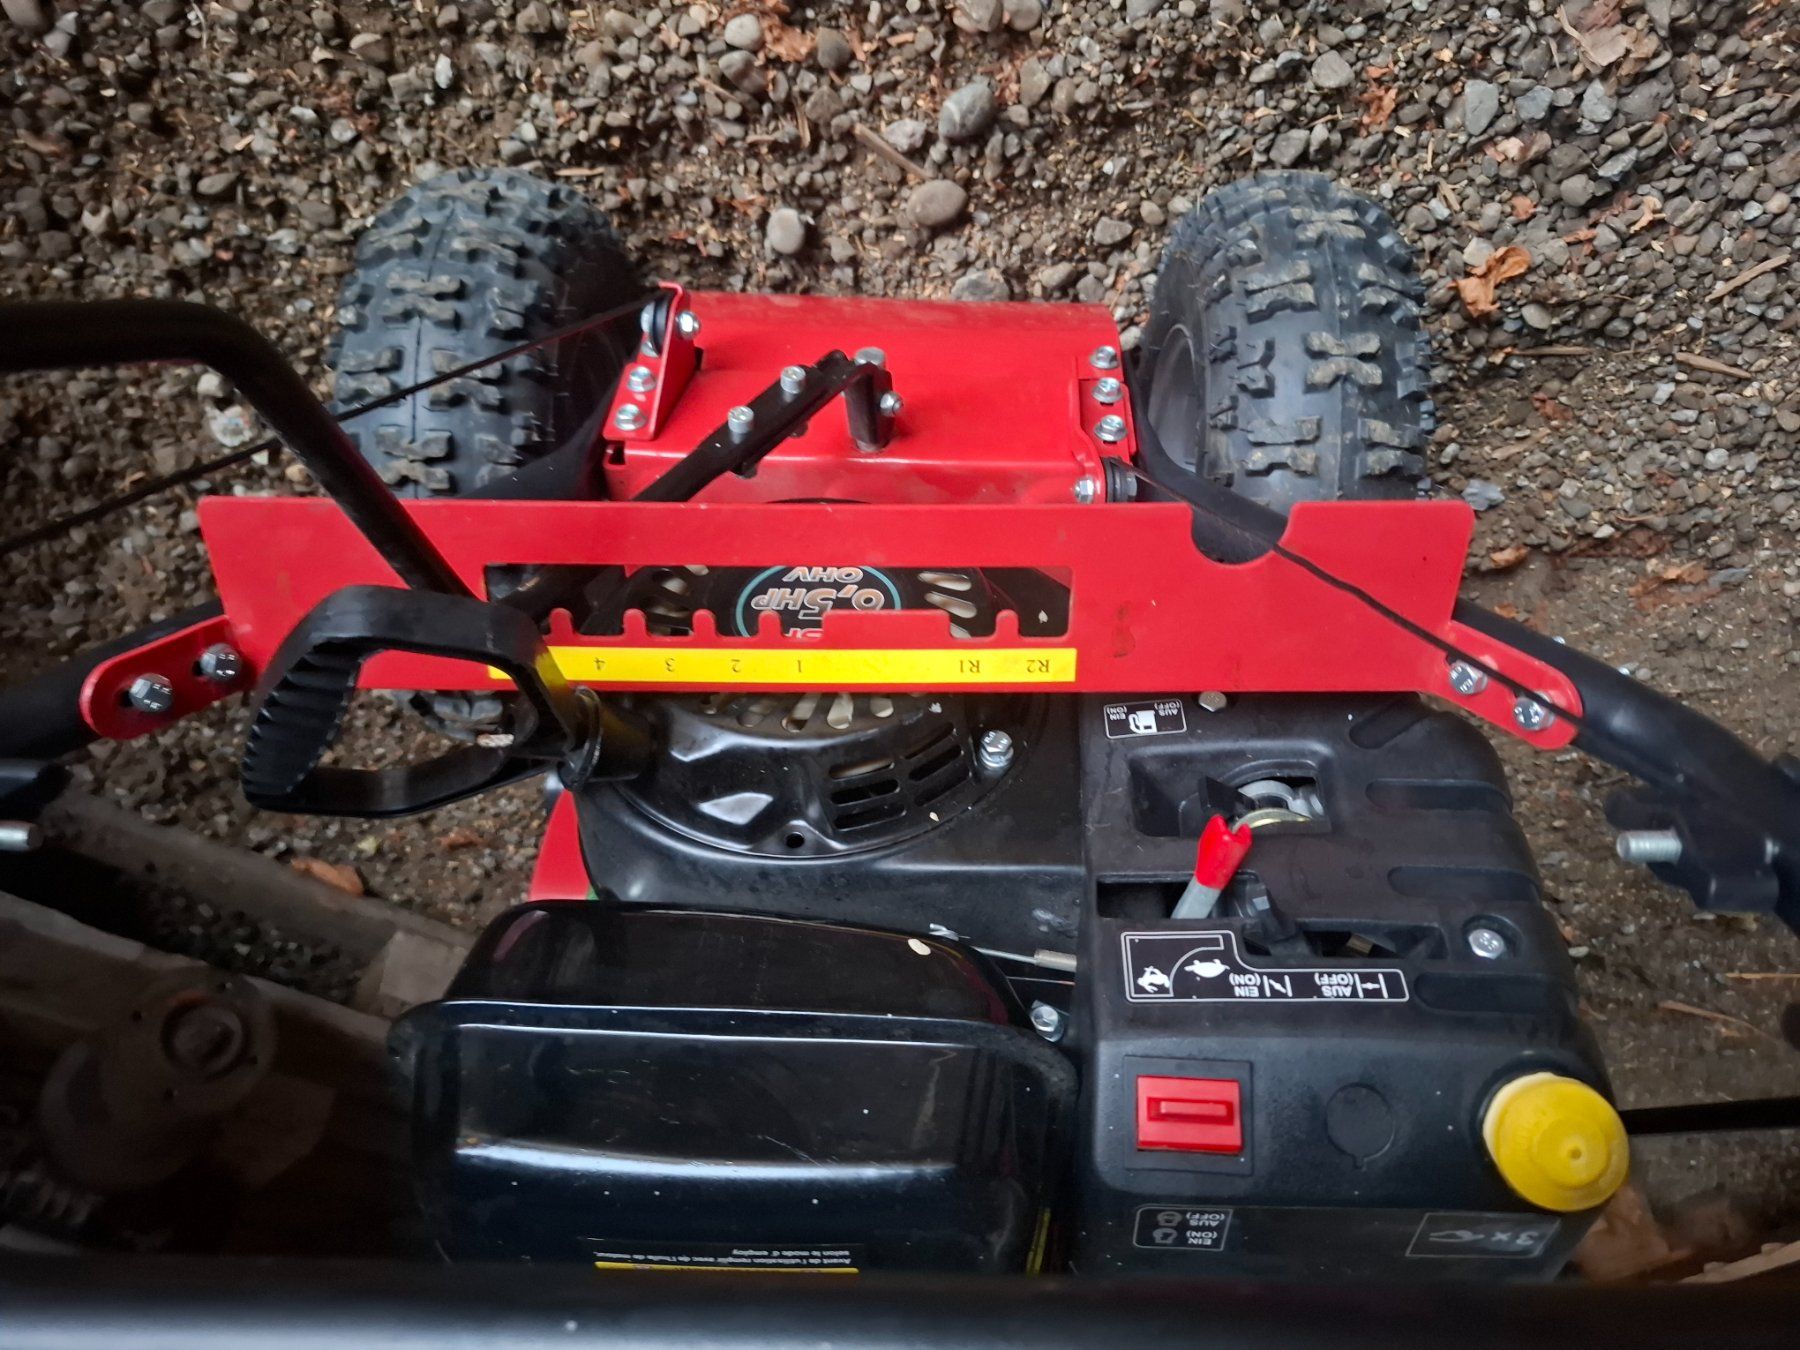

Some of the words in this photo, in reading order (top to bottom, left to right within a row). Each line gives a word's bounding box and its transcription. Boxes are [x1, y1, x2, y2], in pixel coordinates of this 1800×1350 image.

[782, 566, 864, 583] OHV
[594, 657, 605, 670] 4
[665, 657, 675, 672] 3
[731, 658, 742, 673] 2
[960, 659, 981, 673] R1
[1026, 659, 1050, 673] R2
[1106, 705, 1127, 715] (ON)
[1154, 701, 1180, 711] (OFF)
[1158, 708, 1178, 717] AUS
[1109, 712, 1126, 720] EIN
[1229, 973, 1261, 986] (ON)
[1314, 972, 1354, 986] (OFF)
[1234, 986, 1259, 997] EIN
[1321, 985, 1353, 998] AUS
[1185, 1211, 1225, 1221] (OFF)
[1186, 1230, 1218, 1239] (ON)
